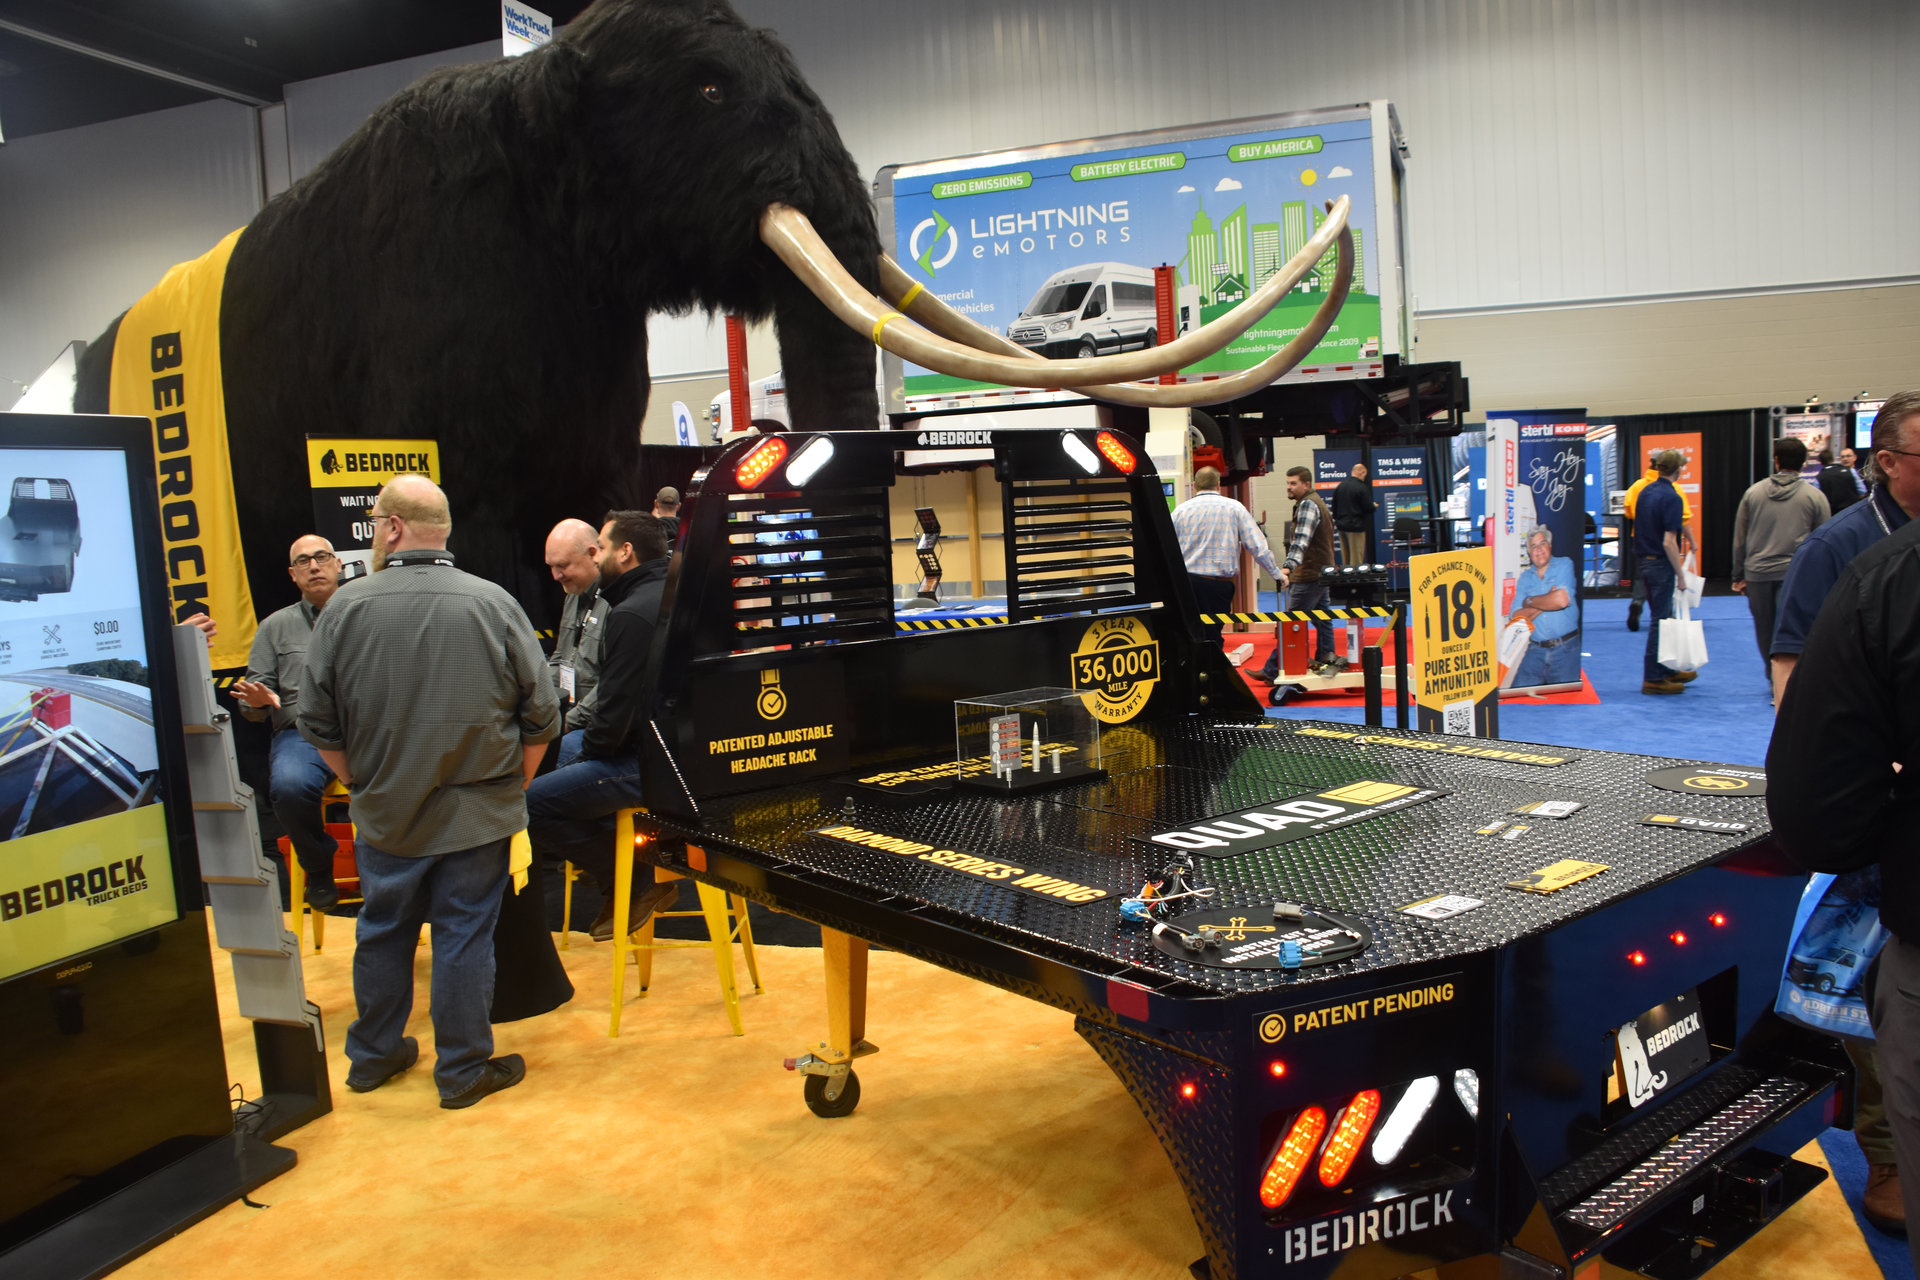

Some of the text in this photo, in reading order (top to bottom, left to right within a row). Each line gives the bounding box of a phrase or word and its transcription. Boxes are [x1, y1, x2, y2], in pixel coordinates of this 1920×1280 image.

[505, 17, 530, 39] Week
[1239, 139, 1314, 158] BUY AMERICA
[1080, 156, 1176, 178] BATTERY ELECTRIC
[940, 175, 1024, 196] ZERO EMISSIONS
[970, 200, 1129, 239] LIGHTNING
[972, 226, 1131, 259] eMOTORS
[937, 288, 974, 301] mercial
[1226, 344, 1266, 355] Sustainable
[1267, 343, 1285, 352] Fleet
[1319, 340, 1338, 348] since
[1339, 338, 1359, 346] 2009
[929, 431, 992, 445] BEDROCK
[1521, 424, 1553, 437] stertil
[345, 453, 430, 472] BEDROCK
[1319, 461, 1335, 469] Core
[1402, 457, 1422, 465] WMS
[151, 330, 210, 625] BEDROCK
[1320, 471, 1347, 479] Services
[1378, 468, 1420, 477] Technology
[340, 495, 365, 507] WAIT
[1505, 489, 1514, 535] stertil
[1418, 561, 1487, 594] FOR A CHANCE TO WIN
[1433, 580, 1475, 642] 18
[94, 620, 119, 635] $0.00
[1092, 618, 1134, 639] 3 YEAR
[0, 641, 10, 651] YS
[1442, 642, 1471, 655] OUNCES OF
[1080, 649, 1152, 683] 36,000
[1424, 650, 1489, 678] PURE SILVER
[1108, 681, 1128, 693] MILE
[1425, 668, 1491, 696] AMMUNITION
[1094, 692, 1142, 717] WARRANTY
[1443, 692, 1460, 702] FOLLOW
[1468, 689, 1474, 697] ON
[709, 724, 834, 755] PATENTED ADJUSTABLE
[1294, 727, 1565, 764] GRANITE SERIES WING
[731, 748, 817, 774] HEADACHE RACK
[911, 758, 982, 774] EXACTLY
[1151, 800, 1346, 849] QUAD
[1680, 818, 1746, 829] QUAD
[816, 826, 1107, 902] DIAMOND SERIES WING
[0, 855, 147, 922] BEDROCK
[86, 881, 148, 907] TRUCK BEDS
[1230, 937, 1285, 954] INSTALL
[1280, 930, 1305, 940] KIT
[1294, 983, 1455, 1033] PATENT PENDING
[1802, 999, 1848, 1016] ADRIAN
[1646, 1012, 1700, 1057] BEDROCK
[1285, 1189, 1454, 1264] BEDROCK
